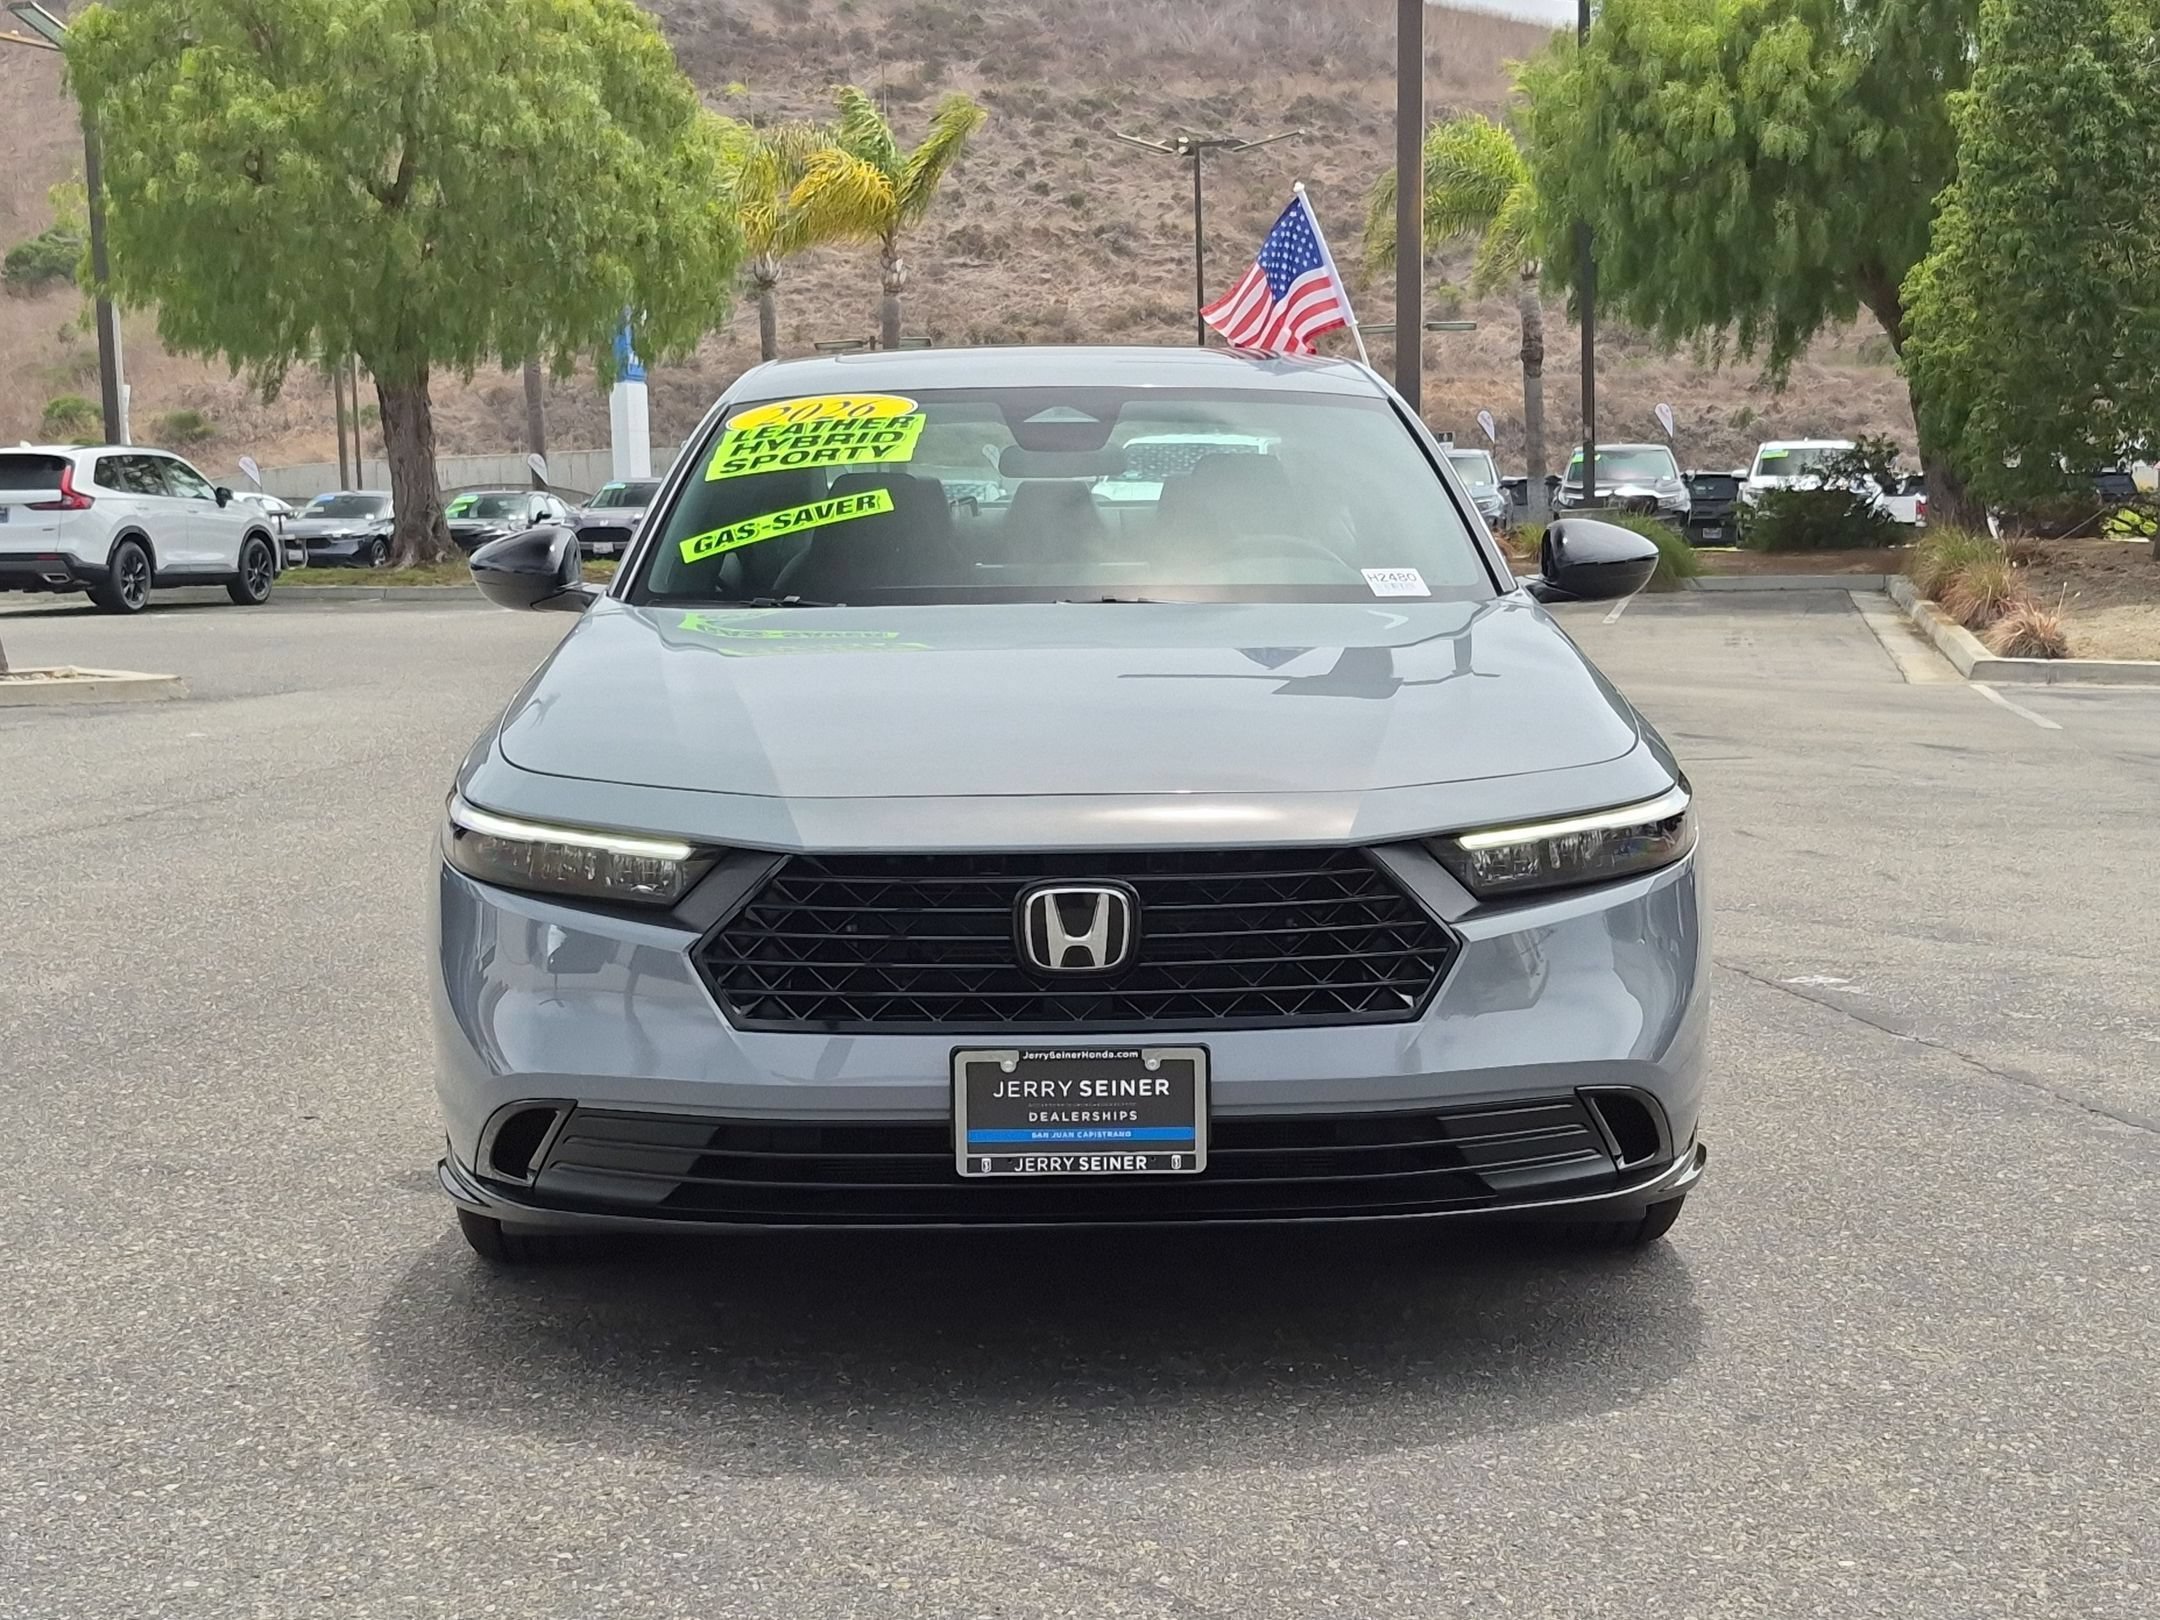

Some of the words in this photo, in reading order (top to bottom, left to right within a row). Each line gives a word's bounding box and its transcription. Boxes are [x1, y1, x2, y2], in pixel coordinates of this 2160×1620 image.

[754, 401, 882, 426] 2026
[732, 416, 916, 443] LEATHER
[729, 430, 906, 457] HYBRID
[719, 444, 897, 474] SPORTY
[692, 494, 879, 554] GAS-SAVER
[1022, 1050, 1139, 1060] JerrySeinerHonda.com
[993, 1080, 1073, 1098] JERRY
[1078, 1078, 1170, 1097] SEINER
[1028, 1110, 1138, 1122] DEALERSHIPS
[1076, 1131, 1132, 1139] CAPISTRANO
[1014, 1157, 1073, 1172] JERRY
[1078, 1156, 1147, 1171] SEINER
